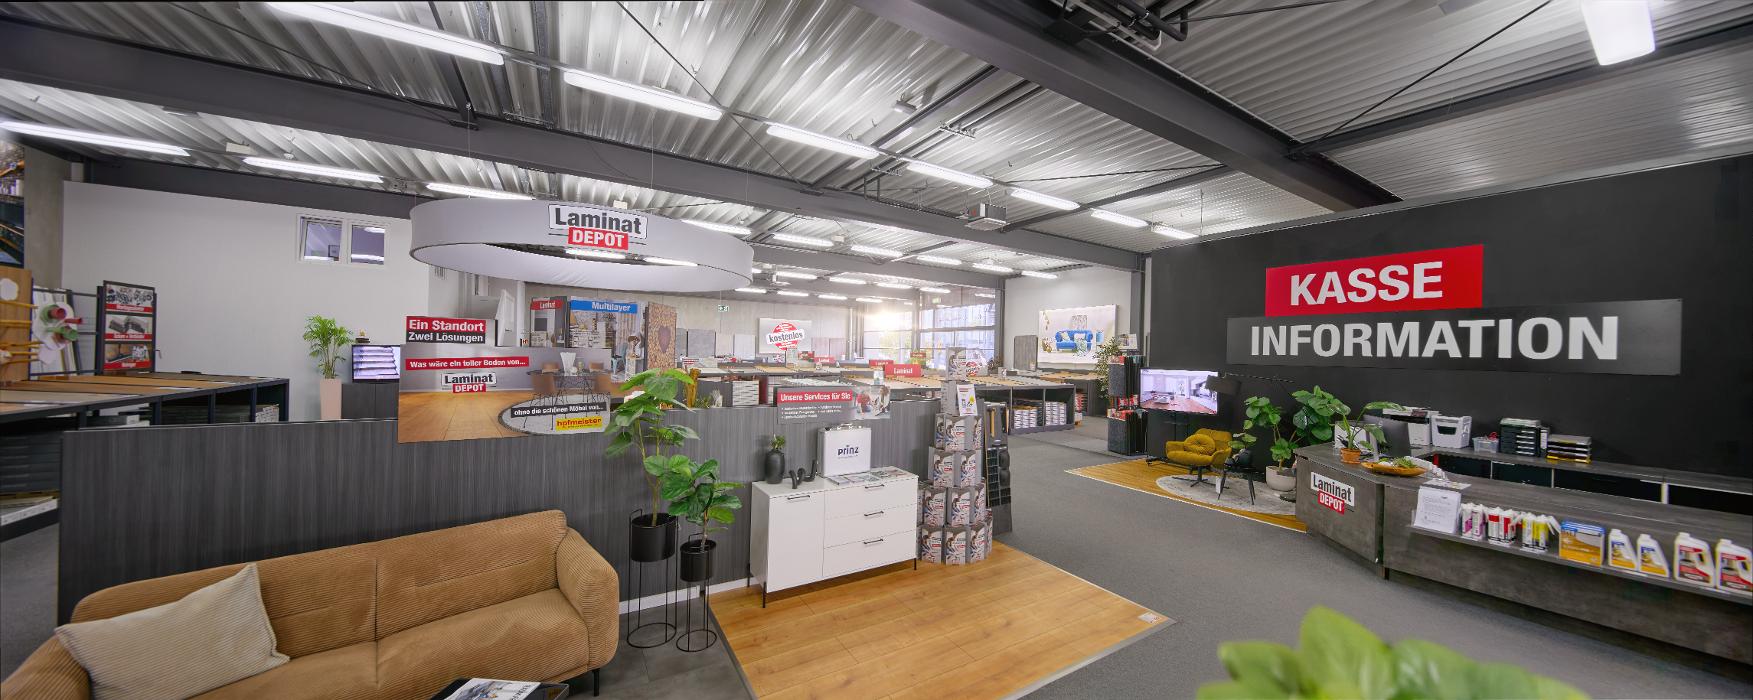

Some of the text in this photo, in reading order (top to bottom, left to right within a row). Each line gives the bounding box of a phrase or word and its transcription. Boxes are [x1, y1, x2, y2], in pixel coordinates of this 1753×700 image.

[555, 207, 642, 235] Laminat
[572, 229, 625, 247] DEPOT
[1290, 261, 1444, 306] KASSE
[592, 301, 631, 311] Multilayer
[409, 319, 484, 332] Ein Standort
[408, 331, 483, 344] Zwei Lösungen
[769, 331, 804, 343] kostenlos
[1251, 316, 1619, 360] INFORMATION
[409, 360, 427, 368] Was
[428, 359, 448, 368] wäre
[449, 359, 461, 367] ein
[463, 359, 482, 367] toller
[483, 359, 506, 367] Boden
[444, 373, 494, 384] Laminat
[454, 383, 484, 392] DEPOT
[780, 391, 851, 402] Unsere Services für Sie
[837, 444, 859, 456] prinz
[1313, 474, 1352, 503] Laminat
[1319, 492, 1343, 512] DEPOT
